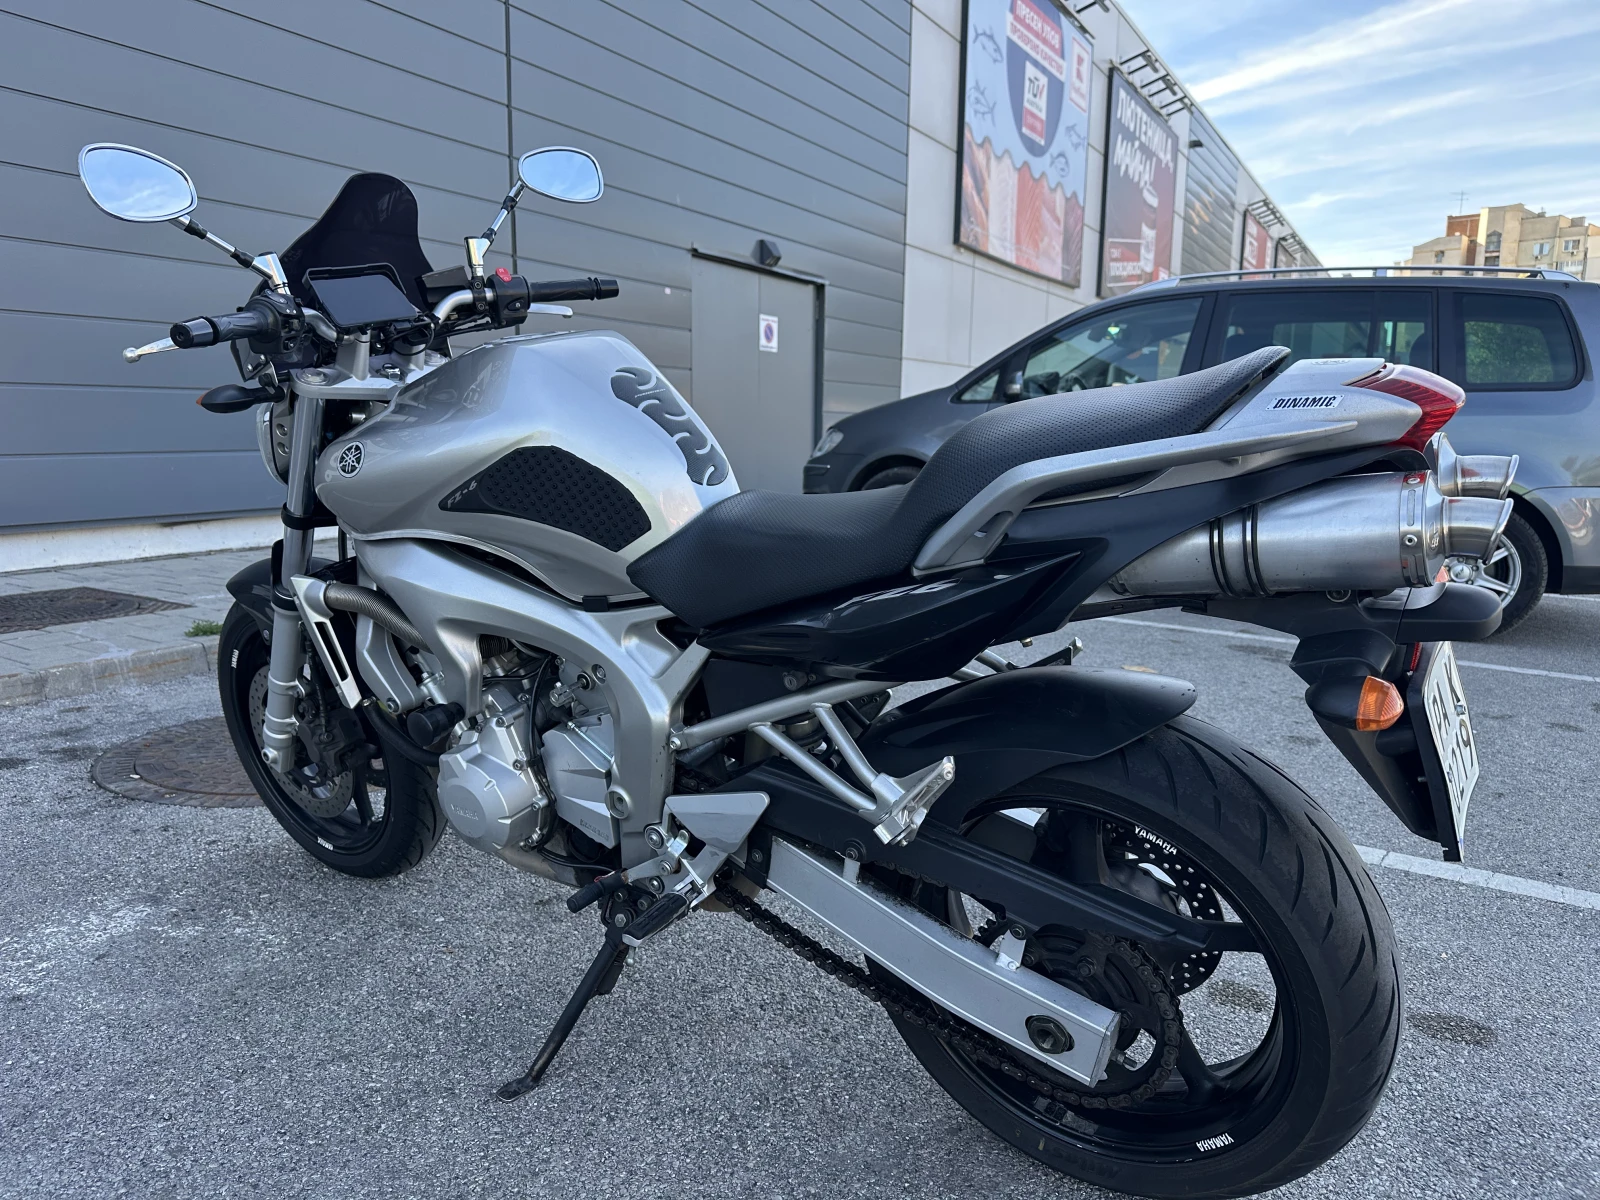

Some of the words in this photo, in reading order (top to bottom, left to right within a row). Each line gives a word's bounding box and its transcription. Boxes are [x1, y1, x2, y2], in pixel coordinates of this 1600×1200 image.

[1272, 395, 1337, 410] DINAMIC
[447, 479, 477, 509] FZ-6
[1135, 825, 1177, 855] YAMAHA
[1195, 1132, 1235, 1152] YAMAHA
